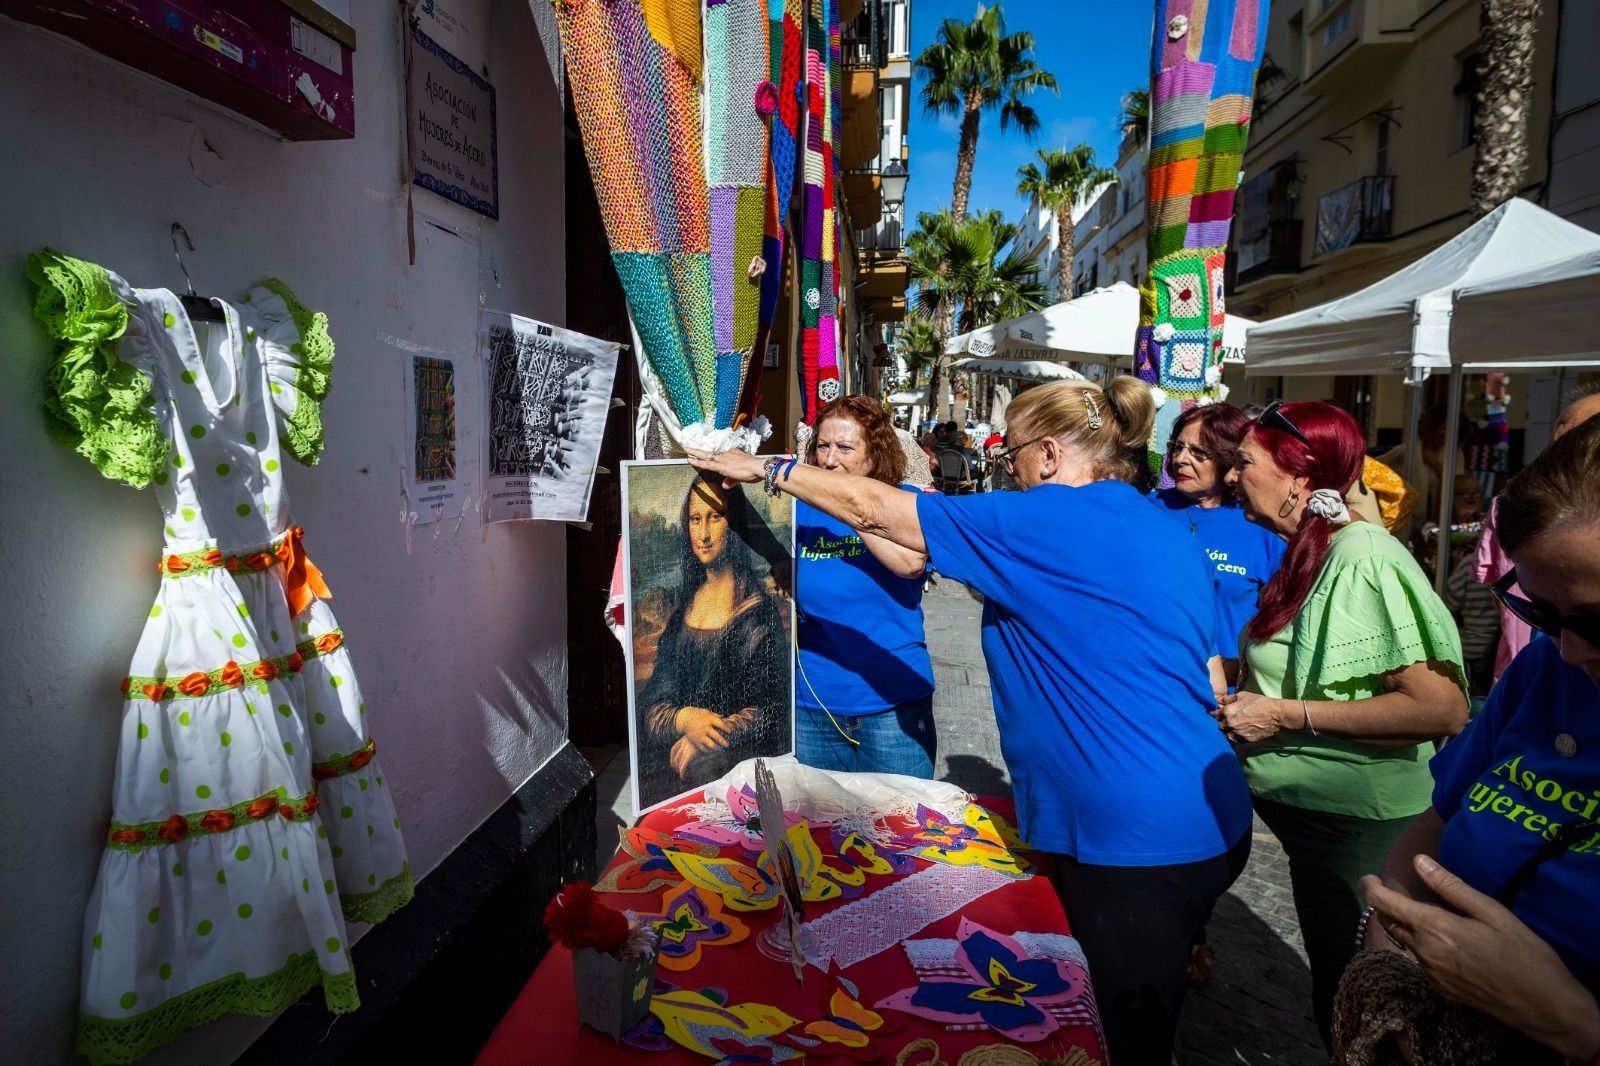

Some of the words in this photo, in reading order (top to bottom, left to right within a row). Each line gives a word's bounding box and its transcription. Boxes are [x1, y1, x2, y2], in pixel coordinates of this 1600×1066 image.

[425, 72, 477, 123] ASOCIACIÓN
[419, 110, 454, 149] MUJERES
[454, 139, 461, 153] DE
[462, 135, 486, 168] ACERO
[848, 546, 861, 557] de
[1216, 563, 1247, 576] cero
